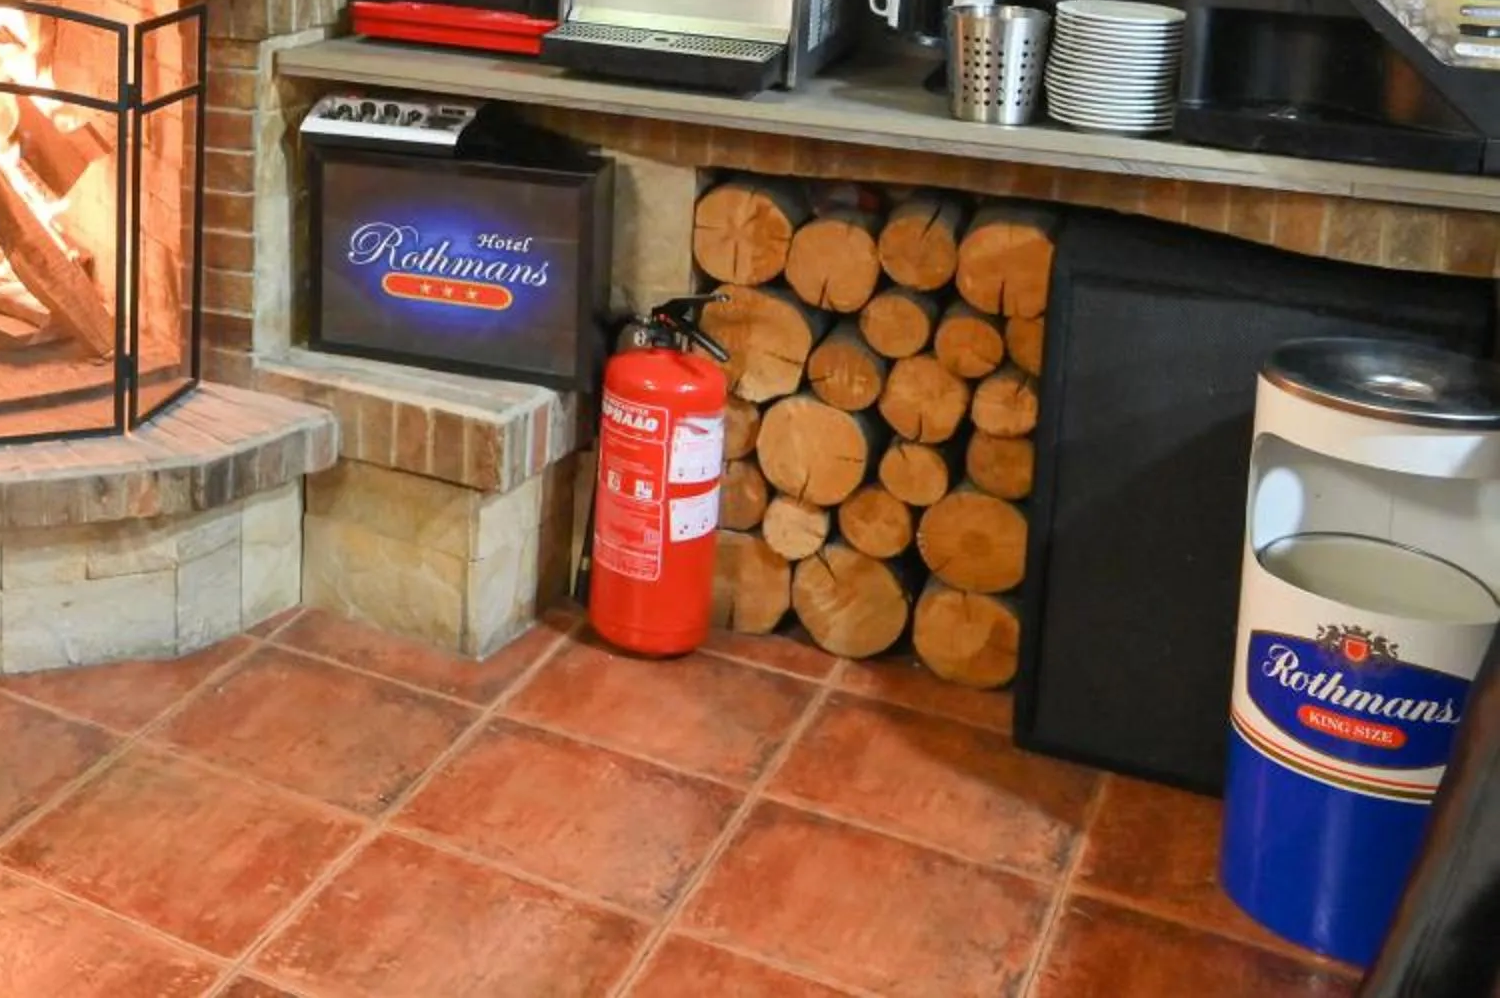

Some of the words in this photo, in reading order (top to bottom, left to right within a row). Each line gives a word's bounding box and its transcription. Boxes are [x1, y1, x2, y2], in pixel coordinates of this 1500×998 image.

[348, 221, 550, 288] Rothmans
[477, 233, 532, 253] Hotel
[1261, 643, 1461, 724] Rothmans
[1308, 711, 1350, 734] KING
[1352, 726, 1393, 744] SIZE
